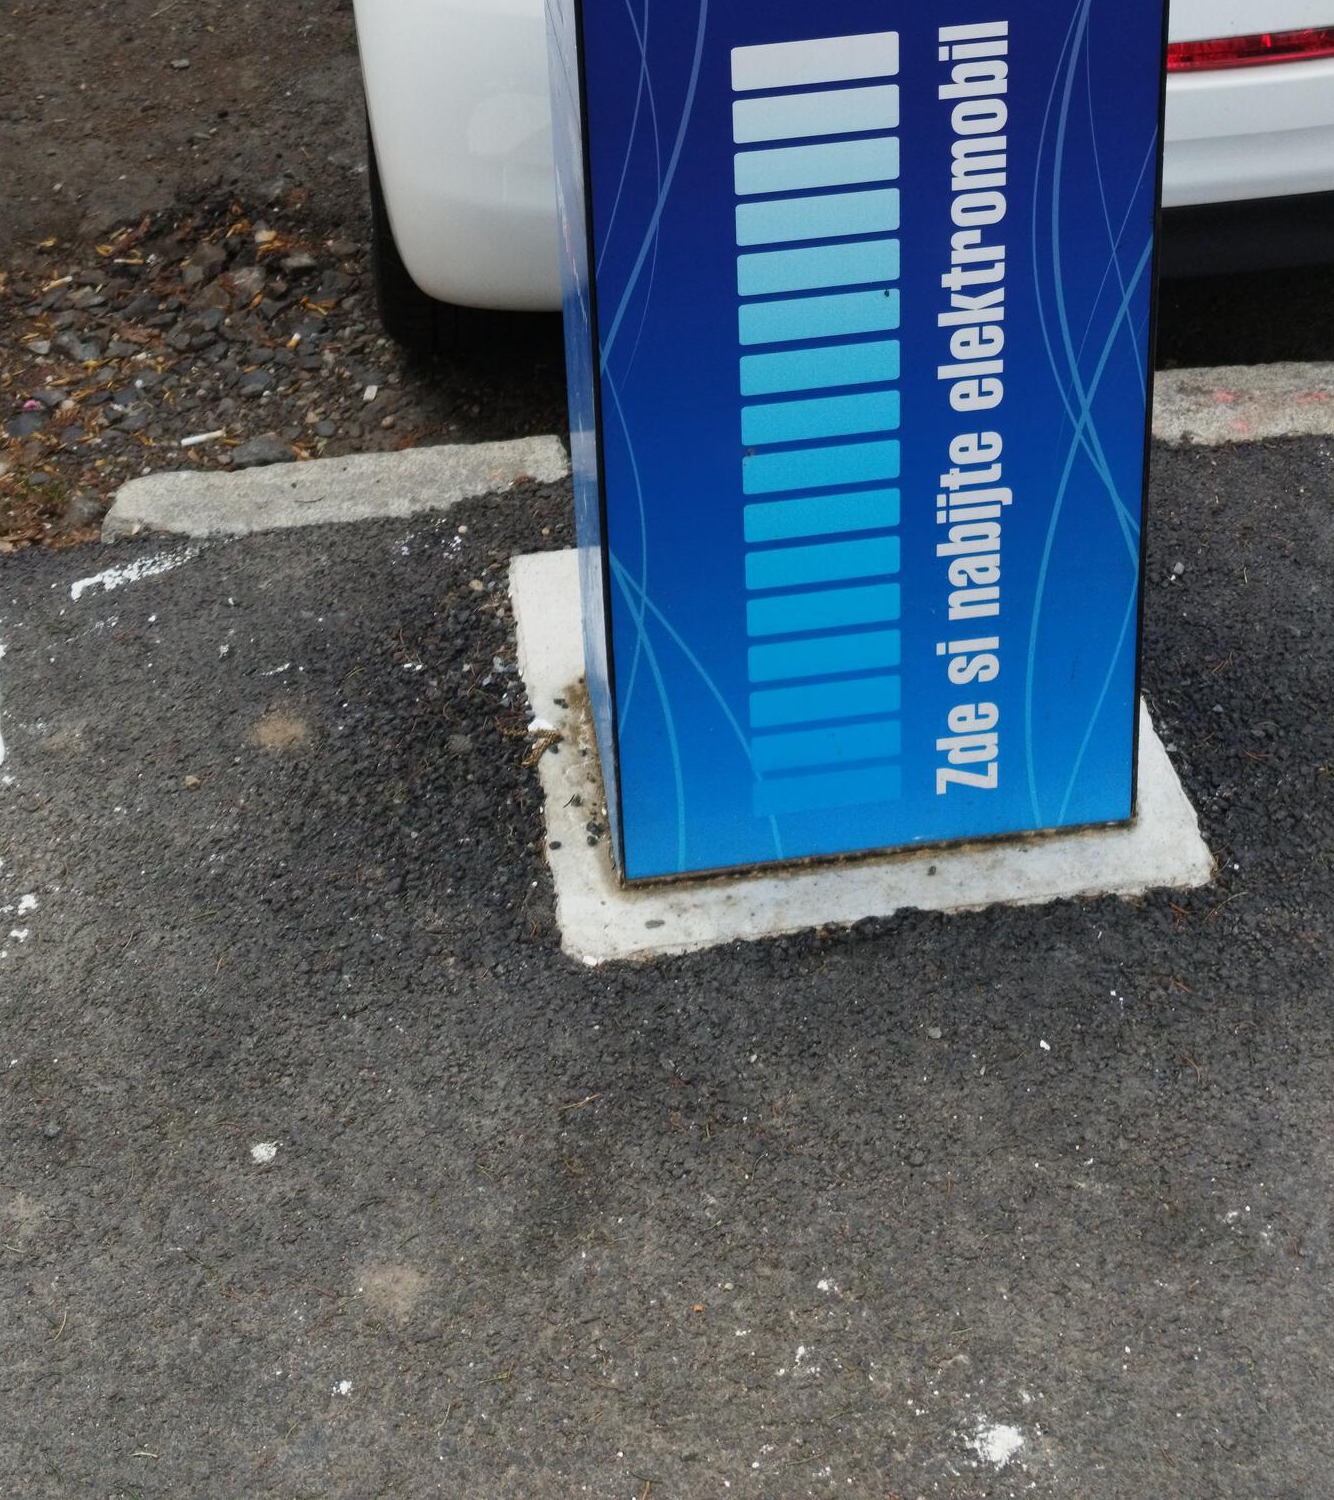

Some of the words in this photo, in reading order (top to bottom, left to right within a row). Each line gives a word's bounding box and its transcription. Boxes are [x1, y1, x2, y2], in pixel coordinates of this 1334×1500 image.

[937, 20, 1009, 411] elektromobil
[937, 431, 1012, 620] nabijte
[937, 636, 999, 684] si
[937, 703, 998, 793] Zde
